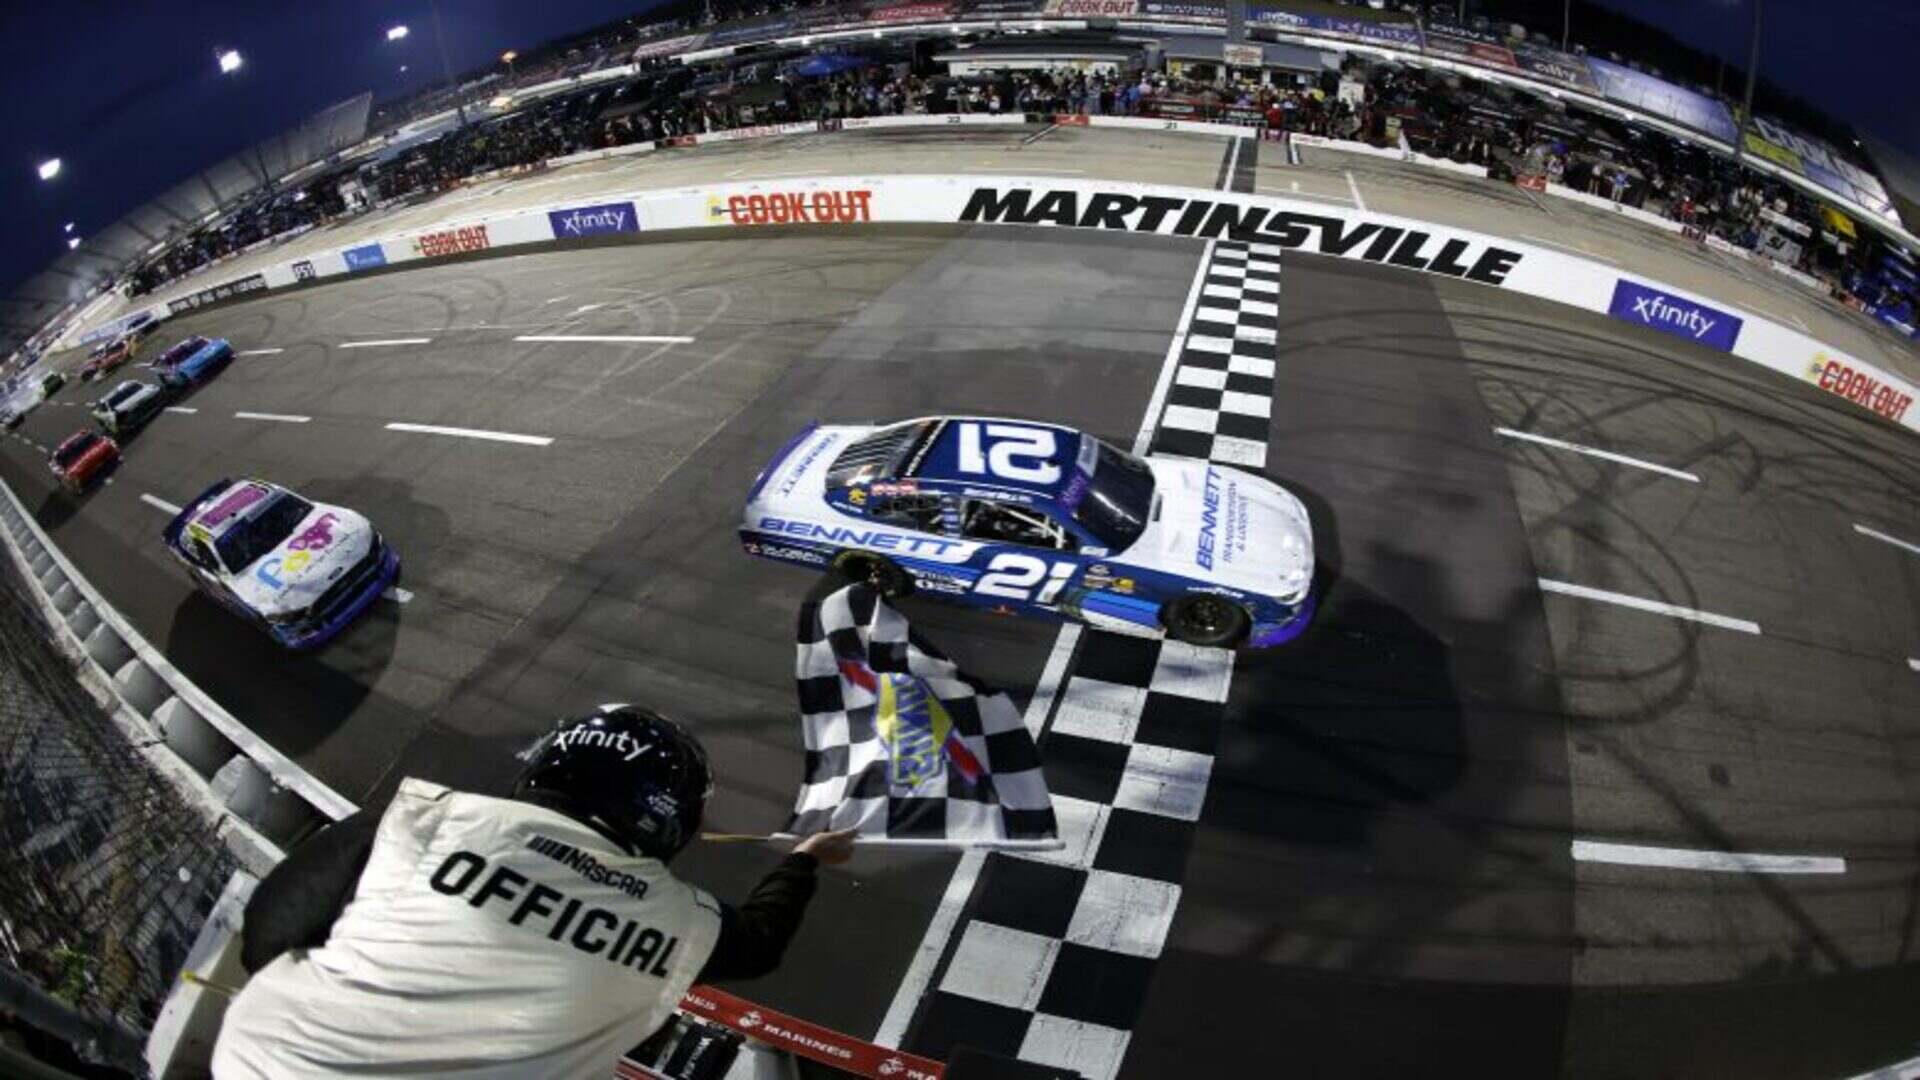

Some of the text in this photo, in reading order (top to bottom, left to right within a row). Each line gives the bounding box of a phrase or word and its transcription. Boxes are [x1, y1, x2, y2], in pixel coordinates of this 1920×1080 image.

[562, 209, 626, 234] xfinity
[728, 190, 873, 225] COOK OUT
[418, 224, 489, 257] COOK OUT
[957, 187, 1524, 285] MARTINSVILLE
[1632, 296, 1716, 338] xfinity
[1818, 361, 1913, 420] COOK OUT
[759, 517, 964, 555] BENNETT
[1196, 466, 1222, 572] BENNETT
[973, 552, 1078, 603] 21
[552, 723, 654, 761] xfinity
[559, 848, 650, 900] NASCAR
[429, 850, 679, 978] OFFICIAL
[764, 1023, 854, 1060] MARINES
